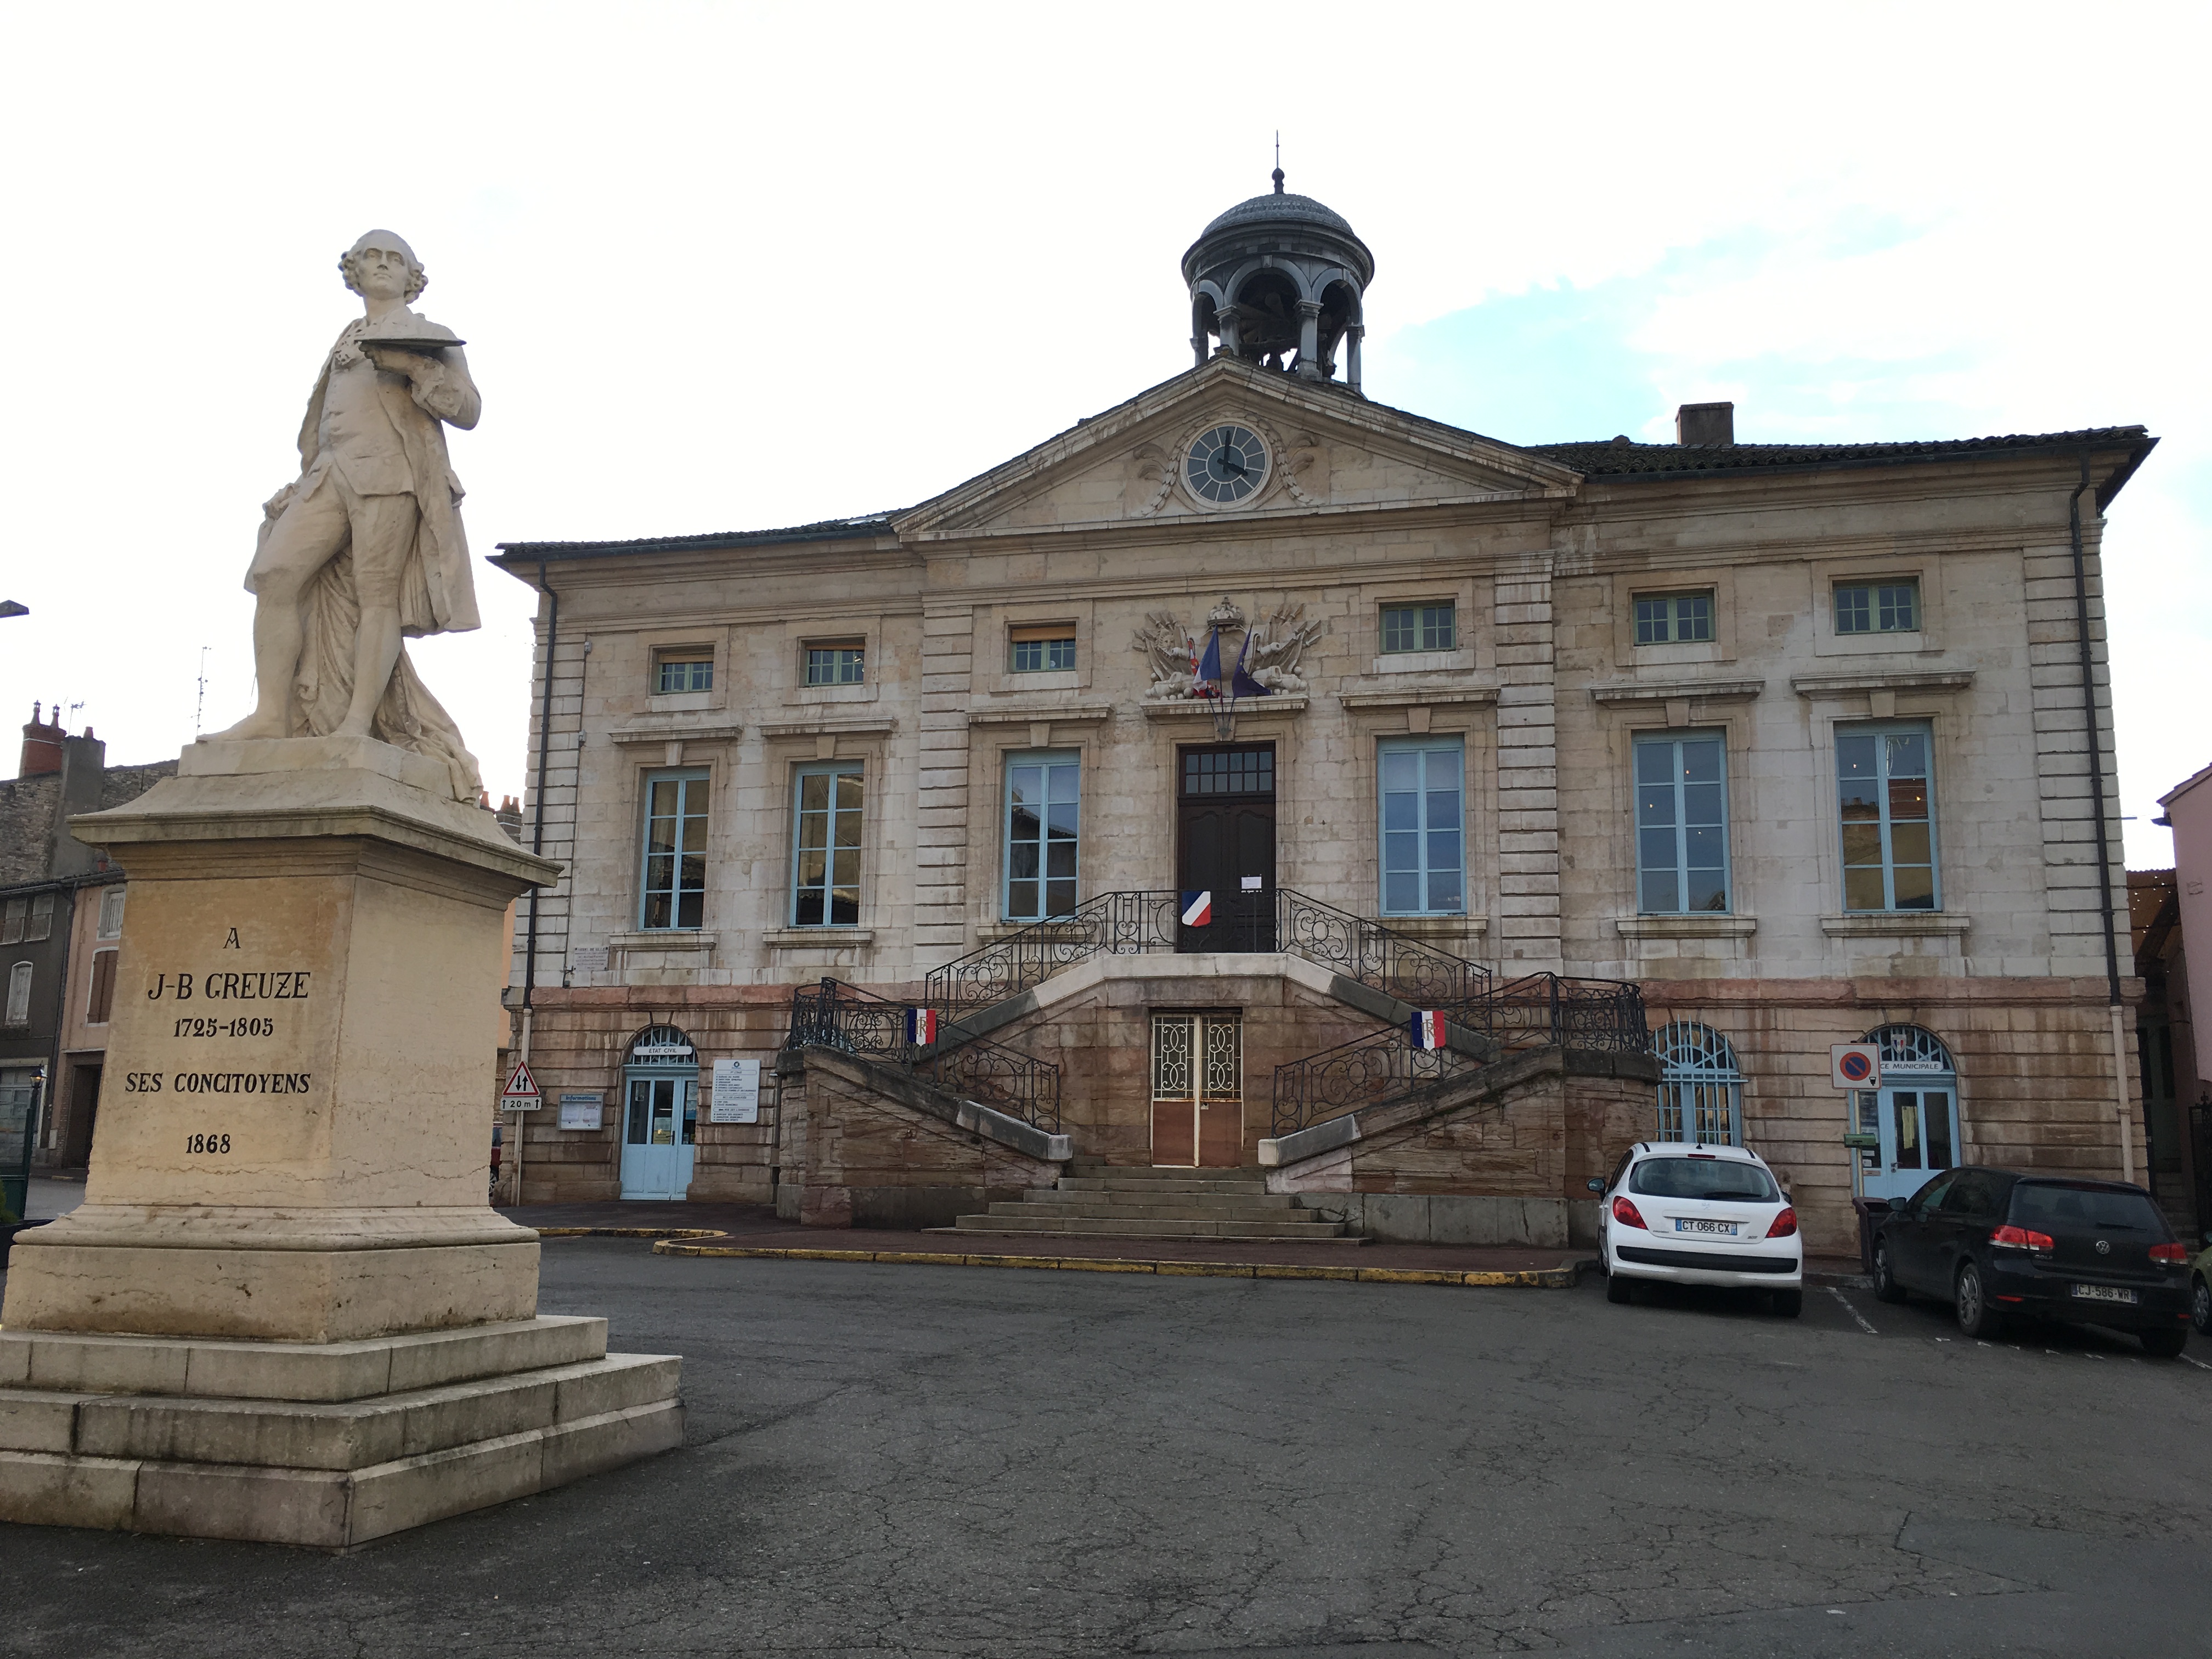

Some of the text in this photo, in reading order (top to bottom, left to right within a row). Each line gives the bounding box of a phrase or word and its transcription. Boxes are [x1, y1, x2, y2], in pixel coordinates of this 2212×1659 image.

[223, 927, 241, 949] A
[148, 972, 311, 1000] J-B GREUZE
[173, 1018, 274, 1037] 1725-1805
[125, 1073, 311, 1094] SES CONCITOYENS
[186, 1133, 231, 1154] 1868
[2078, 1284, 2130, 1300] CJ-586-WR
